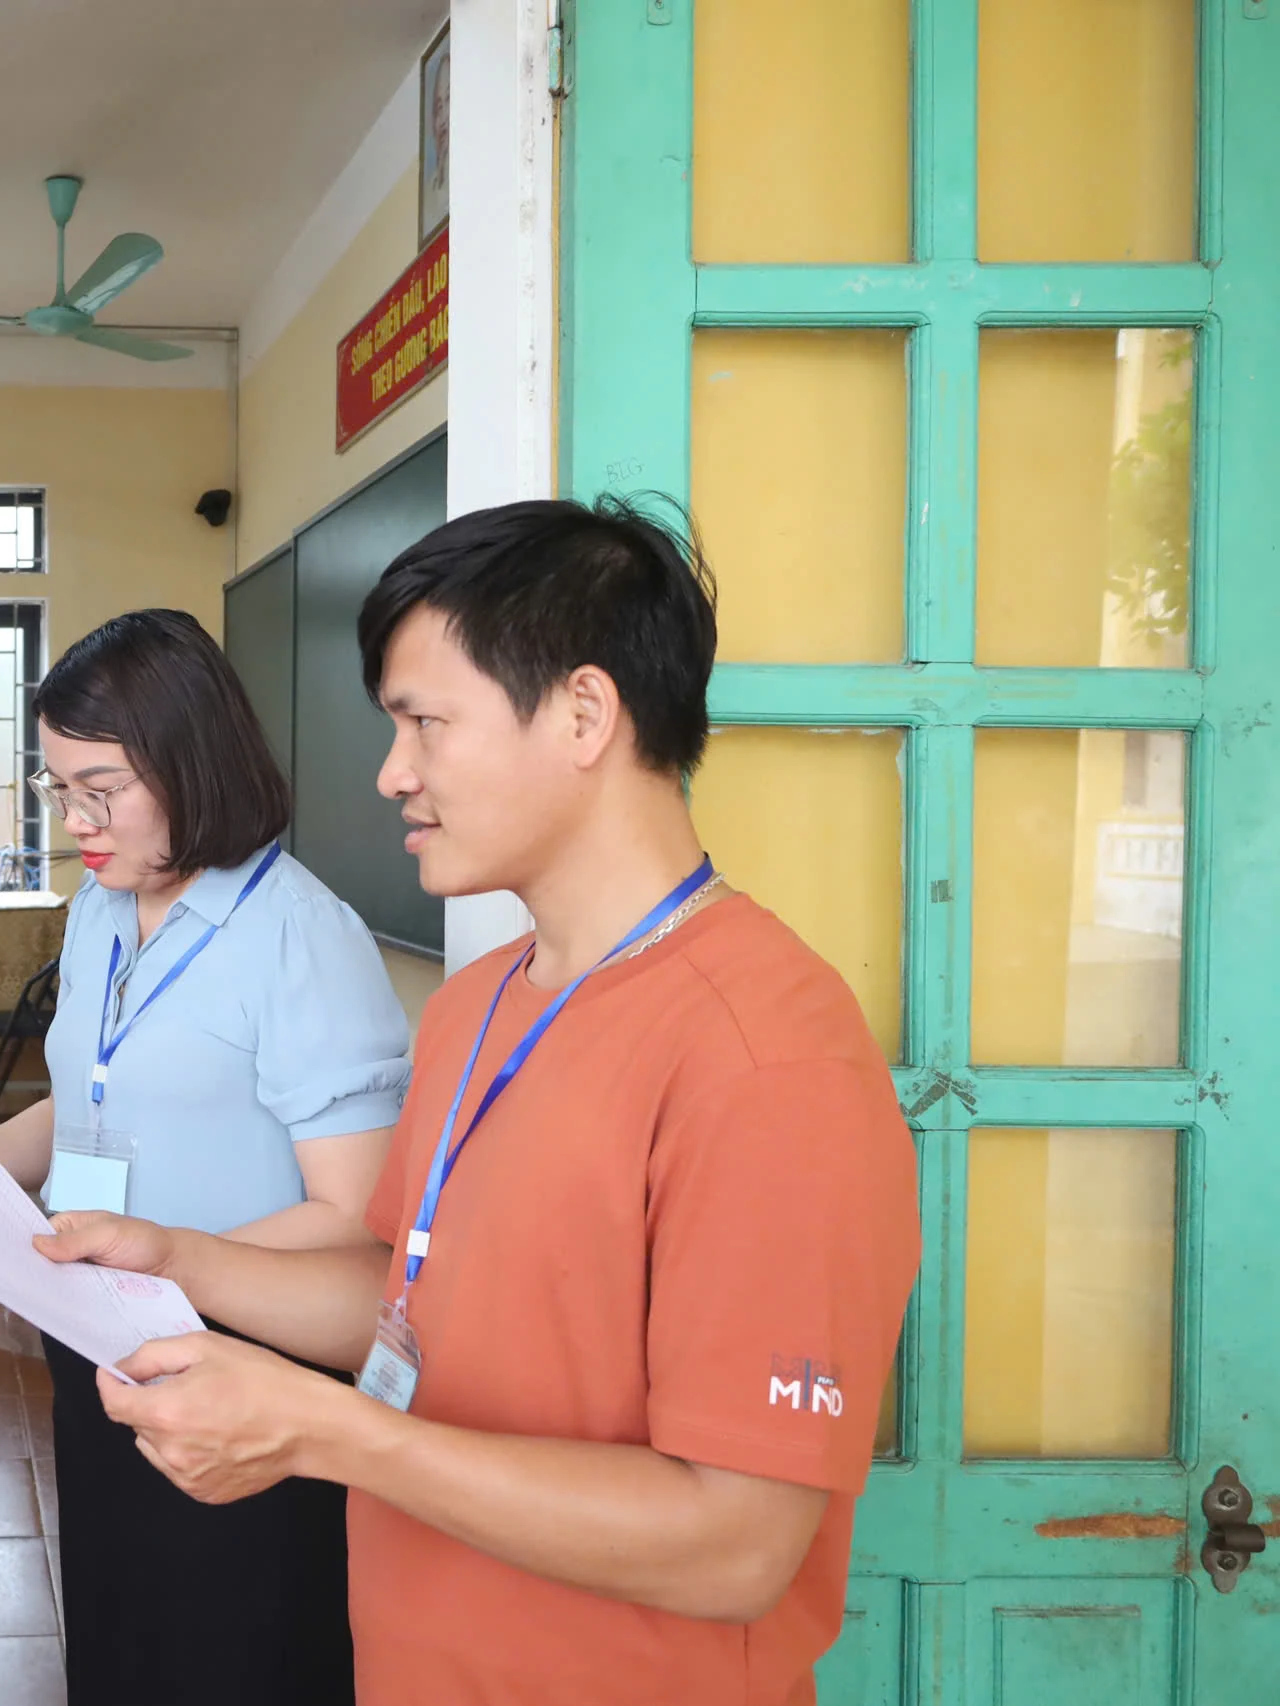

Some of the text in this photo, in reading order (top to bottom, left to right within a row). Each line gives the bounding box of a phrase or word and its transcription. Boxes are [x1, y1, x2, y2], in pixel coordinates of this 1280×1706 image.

[427, 253, 448, 303] LAO
[371, 358, 393, 403] THEO
[769, 1360, 843, 1417] MIND
